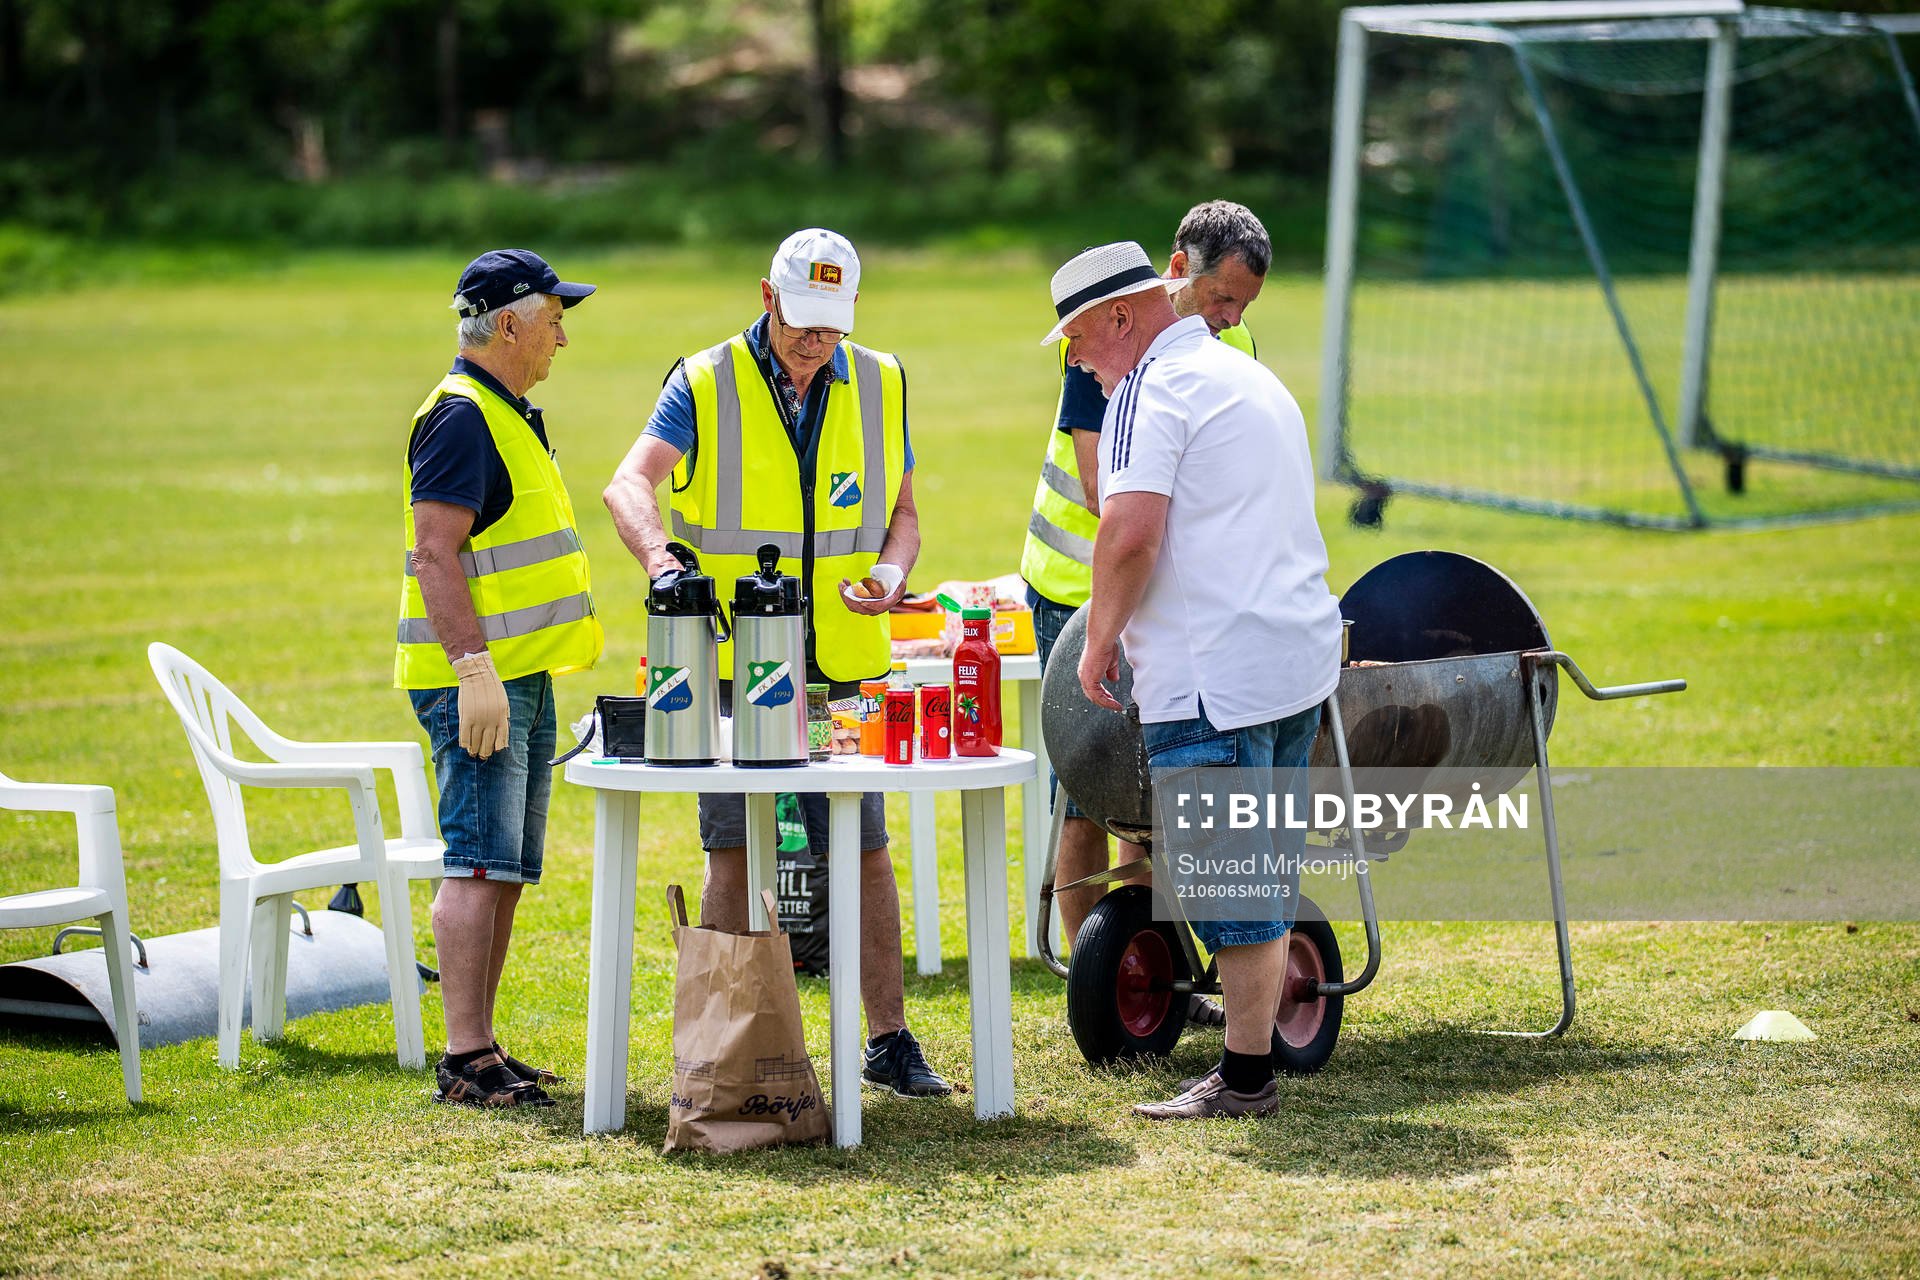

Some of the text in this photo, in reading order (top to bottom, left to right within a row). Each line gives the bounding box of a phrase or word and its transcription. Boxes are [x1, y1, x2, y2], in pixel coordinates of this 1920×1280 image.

[958, 666, 977, 676] FELIX
[670, 696, 689, 704] 1994
[773, 690, 791, 699] 1994
[860, 697, 881, 713] NTA
[777, 871, 813, 897] ILL
[777, 900, 811, 914] ETTER
[739, 1091, 816, 1121] Börjes
